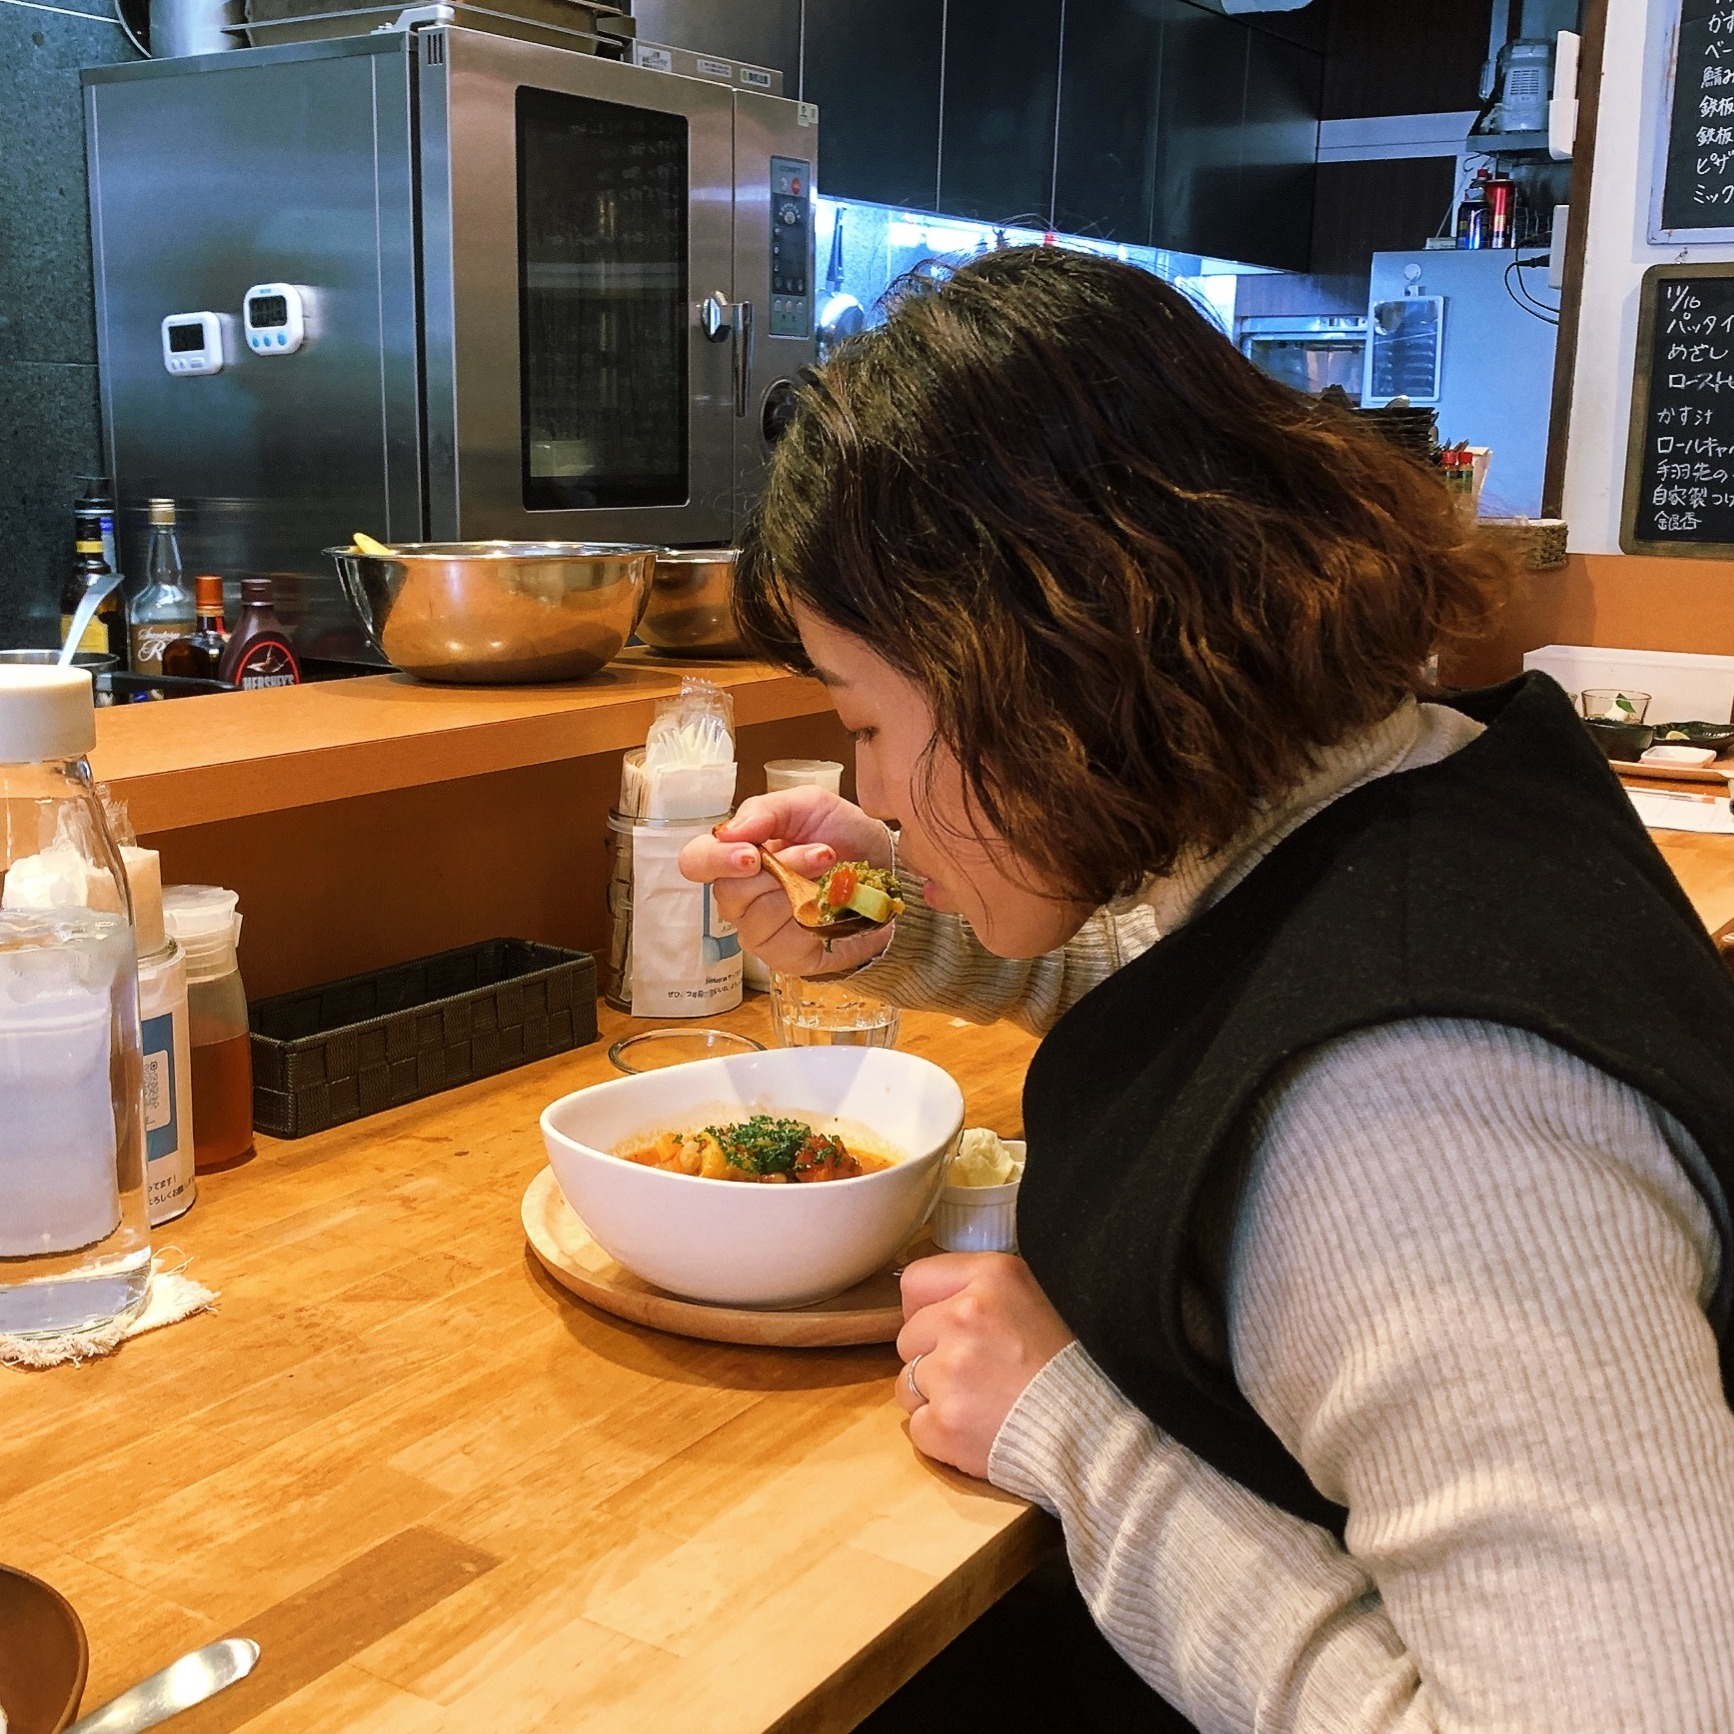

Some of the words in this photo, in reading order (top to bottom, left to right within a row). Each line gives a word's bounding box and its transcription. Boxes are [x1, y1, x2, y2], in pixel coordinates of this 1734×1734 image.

[1699, 94, 1734, 118] 鉄板
[1696, 125, 1734, 147] 鉄板
[1666, 311, 1734, 335] パッタイ
[1667, 343, 1728, 362] めざし
[1657, 405, 1713, 426] かす汁
[1656, 459, 1734, 483] 手羽先の
